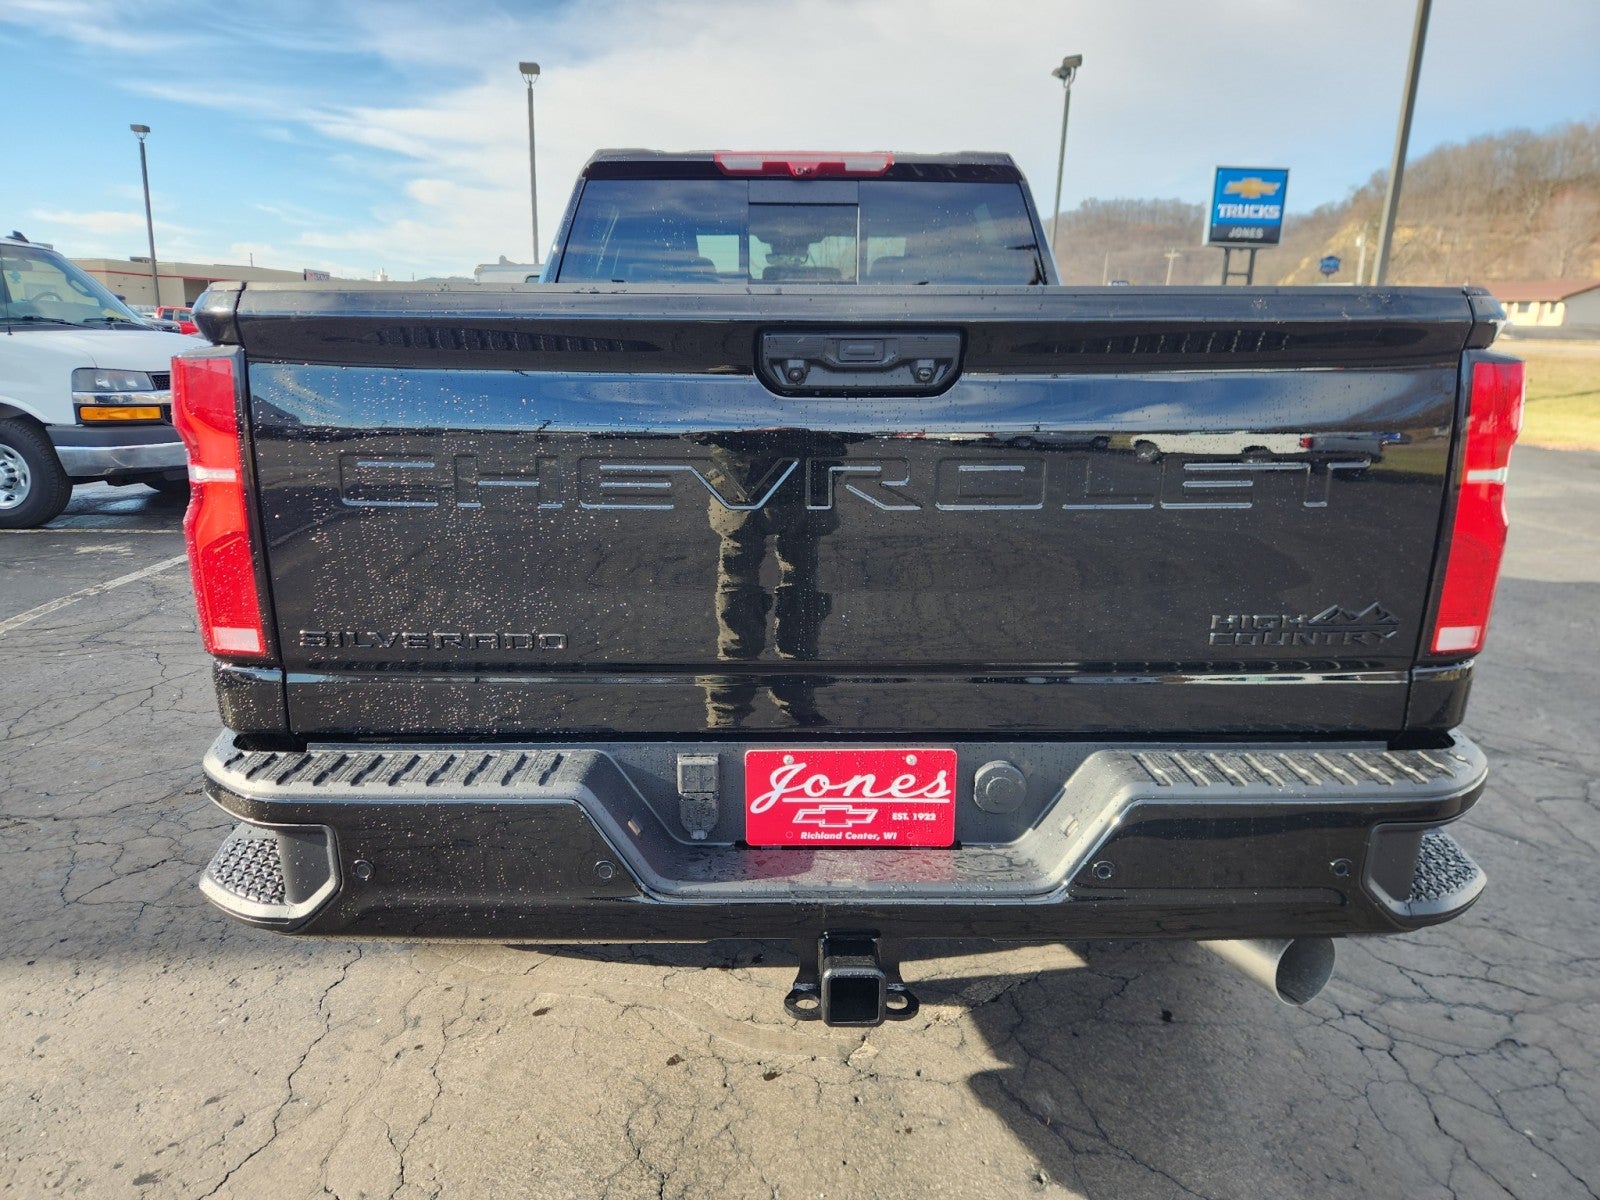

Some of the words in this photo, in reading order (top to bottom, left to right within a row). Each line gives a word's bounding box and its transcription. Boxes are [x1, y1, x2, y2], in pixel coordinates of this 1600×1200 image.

[1217, 203, 1281, 219] TRUCKS
[1228, 226, 1264, 239] JONES
[339, 453, 1372, 511] CHEVROLET
[1210, 614, 1308, 630] HIGH
[300, 630, 569, 649] SILVERADO
[1208, 630, 1397, 646] COUNTRY
[750, 763, 951, 814] Jones
[892, 812, 910, 821] EST.
[912, 812, 937, 821] 1922
[800, 831, 843, 840] Richland
[845, 831, 880, 841] Center,
[883, 831, 897, 840] WI
